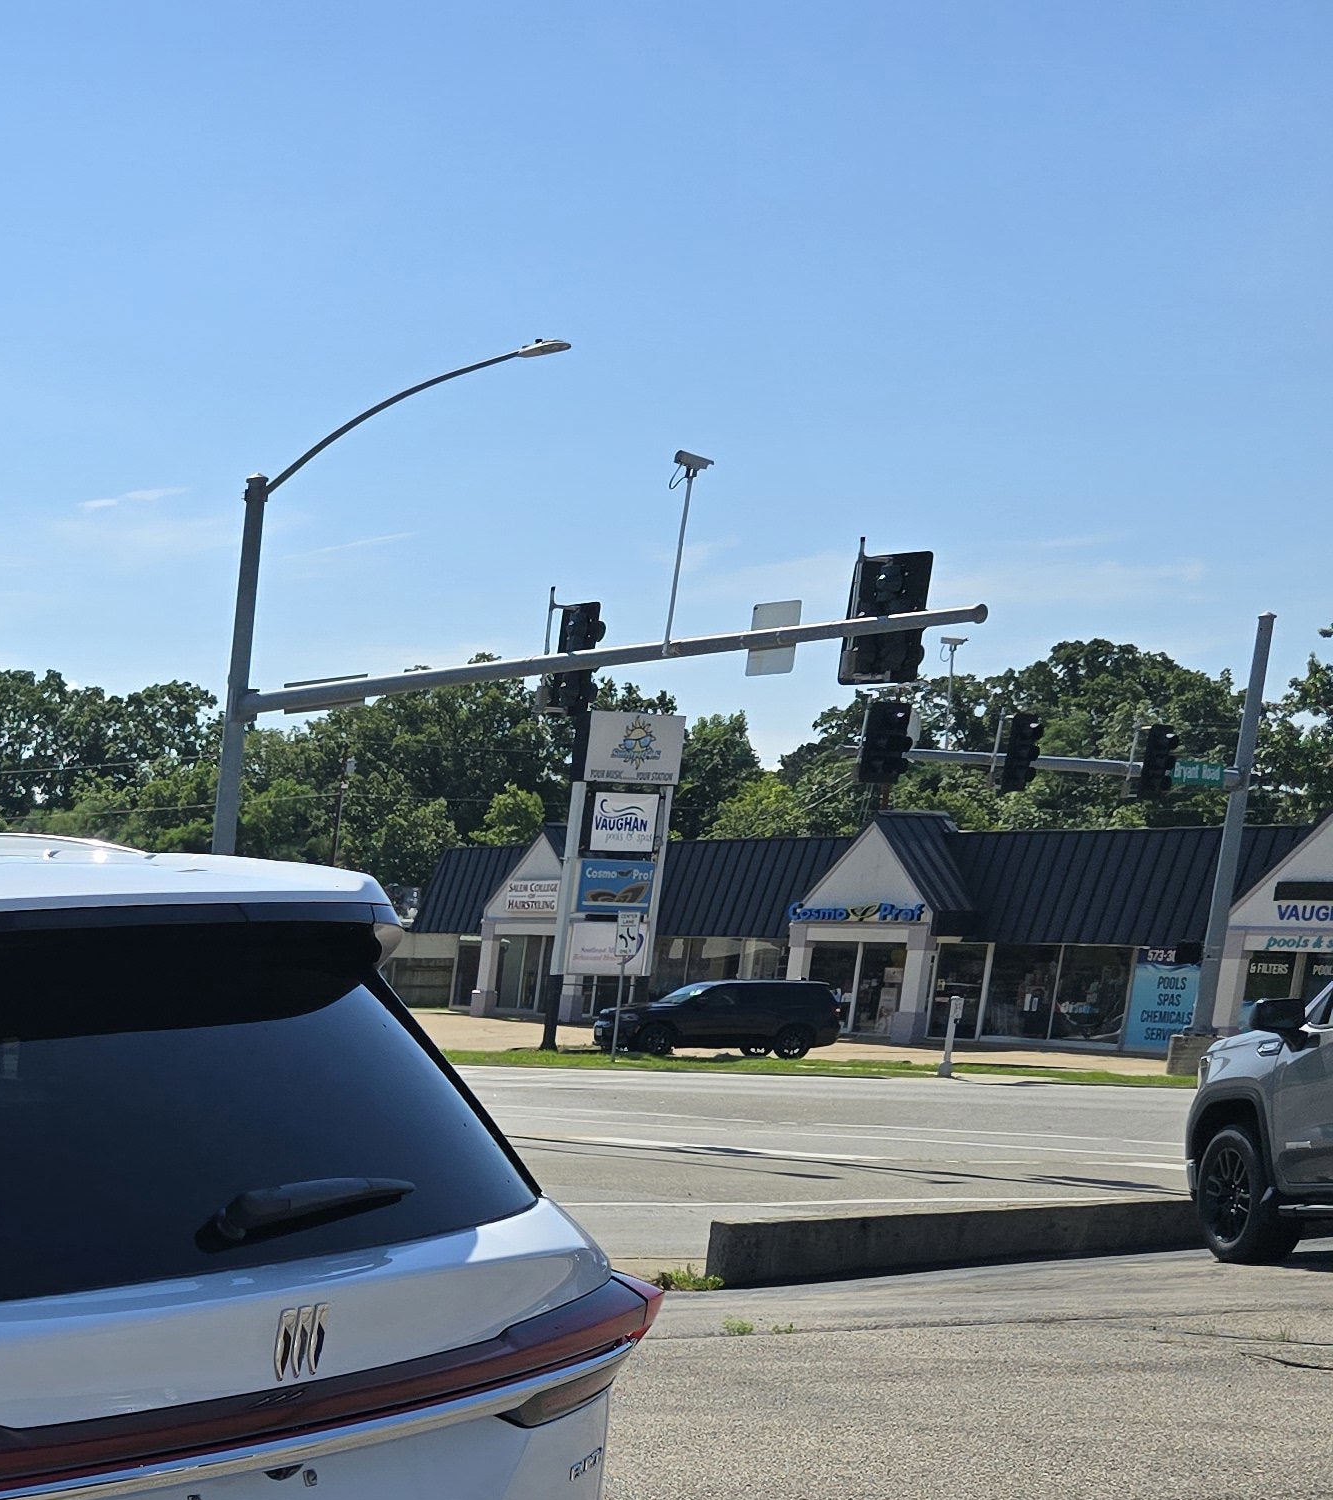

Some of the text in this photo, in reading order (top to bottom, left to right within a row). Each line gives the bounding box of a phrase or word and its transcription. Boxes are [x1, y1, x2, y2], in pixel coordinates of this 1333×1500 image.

[1174, 761, 1221, 782] Bryant Road
[594, 815, 648, 832] VAUGHAN
[605, 832, 624, 843] pools
[636, 833, 653, 844] spas
[585, 867, 618, 879] Cosmo
[788, 901, 926, 921] Cosmo Prof
[1264, 936, 1310, 952] pools
[1312, 935, 1324, 949] &
[1257, 963, 1289, 975] FILTERS
[1157, 976, 1187, 990] POOLS
[1157, 993, 1182, 1007] SPAS
[1140, 1009, 1193, 1025] CHEMICALS
